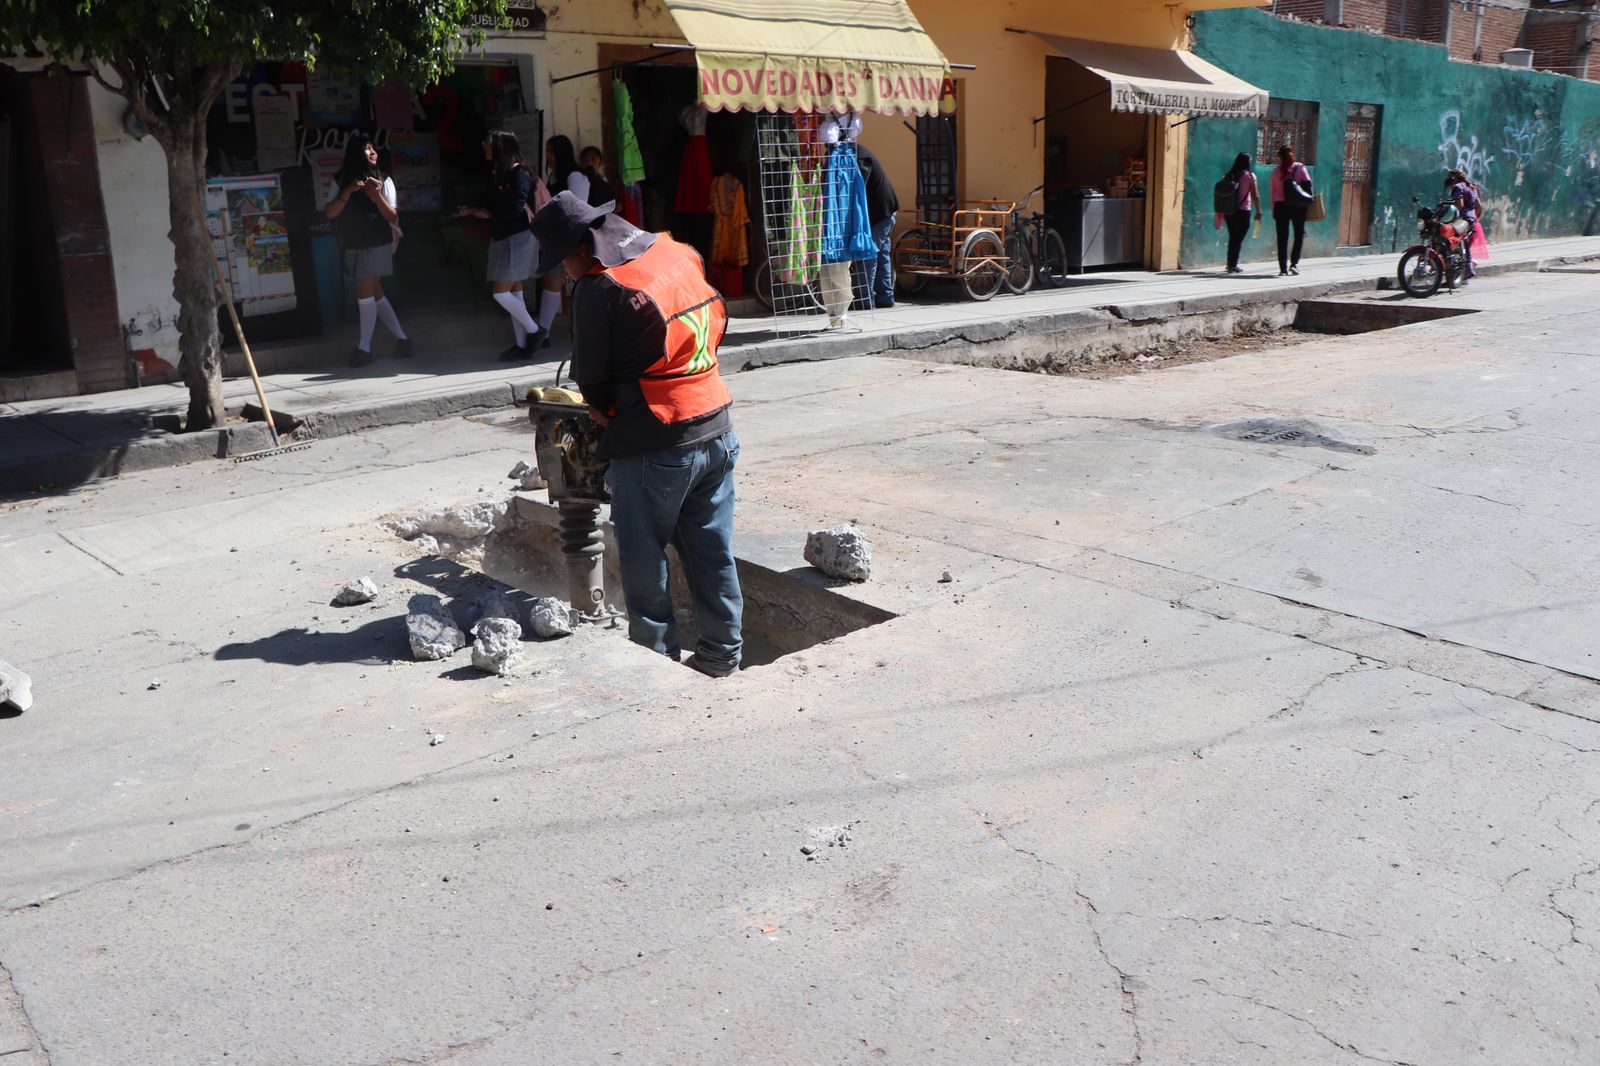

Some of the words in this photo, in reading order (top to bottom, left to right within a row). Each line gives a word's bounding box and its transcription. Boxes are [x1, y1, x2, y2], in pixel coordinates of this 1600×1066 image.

[701, 68, 857, 97] NOVEDADES
[1116, 89, 1190, 108] TORTILLERIA
[1194, 96, 1208, 109] LA
